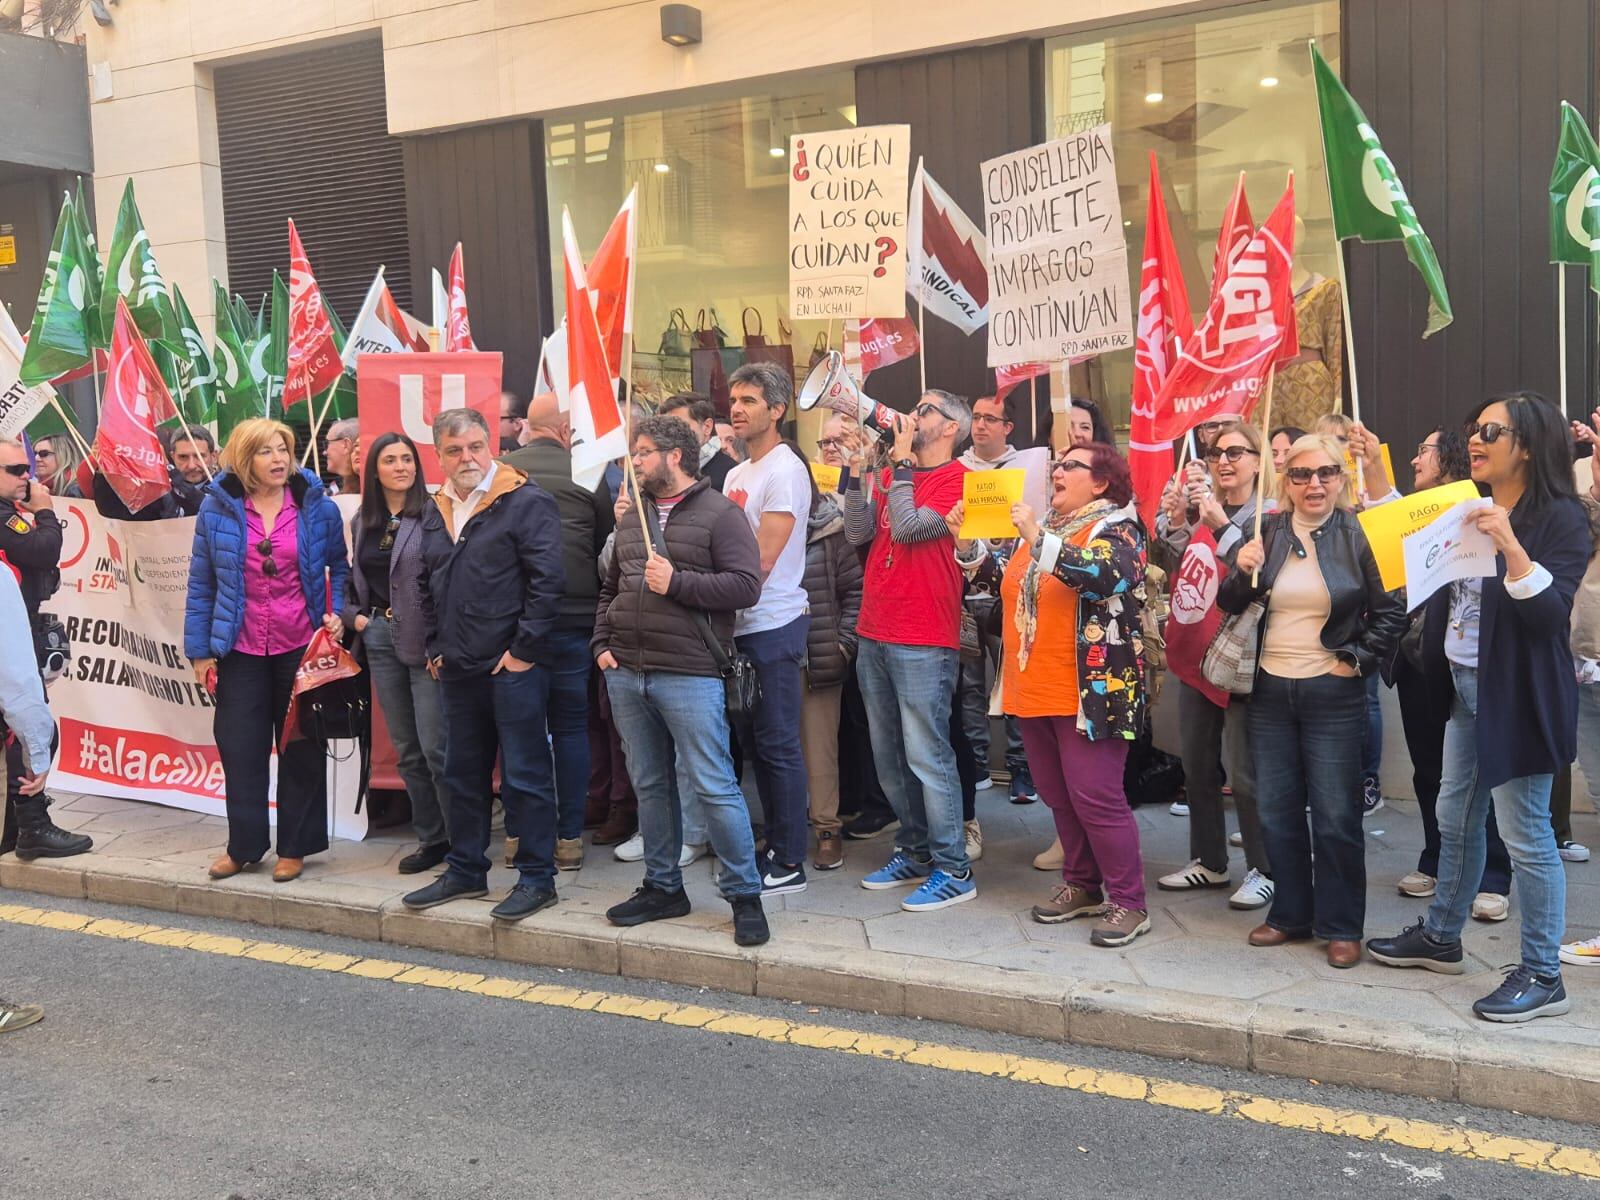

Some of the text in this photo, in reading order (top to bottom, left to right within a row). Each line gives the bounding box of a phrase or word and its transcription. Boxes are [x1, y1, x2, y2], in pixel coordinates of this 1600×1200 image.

[810, 176, 883, 202] CUIDA
[794, 208, 904, 233] A LOS QUE
[990, 180, 1113, 248] PROMETE,
[991, 240, 1094, 297] IMPAGOS
[796, 304, 810, 316] EN
[993, 284, 1118, 347] CONTINÚAN
[1080, 337, 1108, 352] SANTA
[1111, 334, 1128, 347] FAZ
[1409, 503, 1440, 520] PAGO
[162, 642, 185, 670] DE
[182, 681, 195, 706] Y
